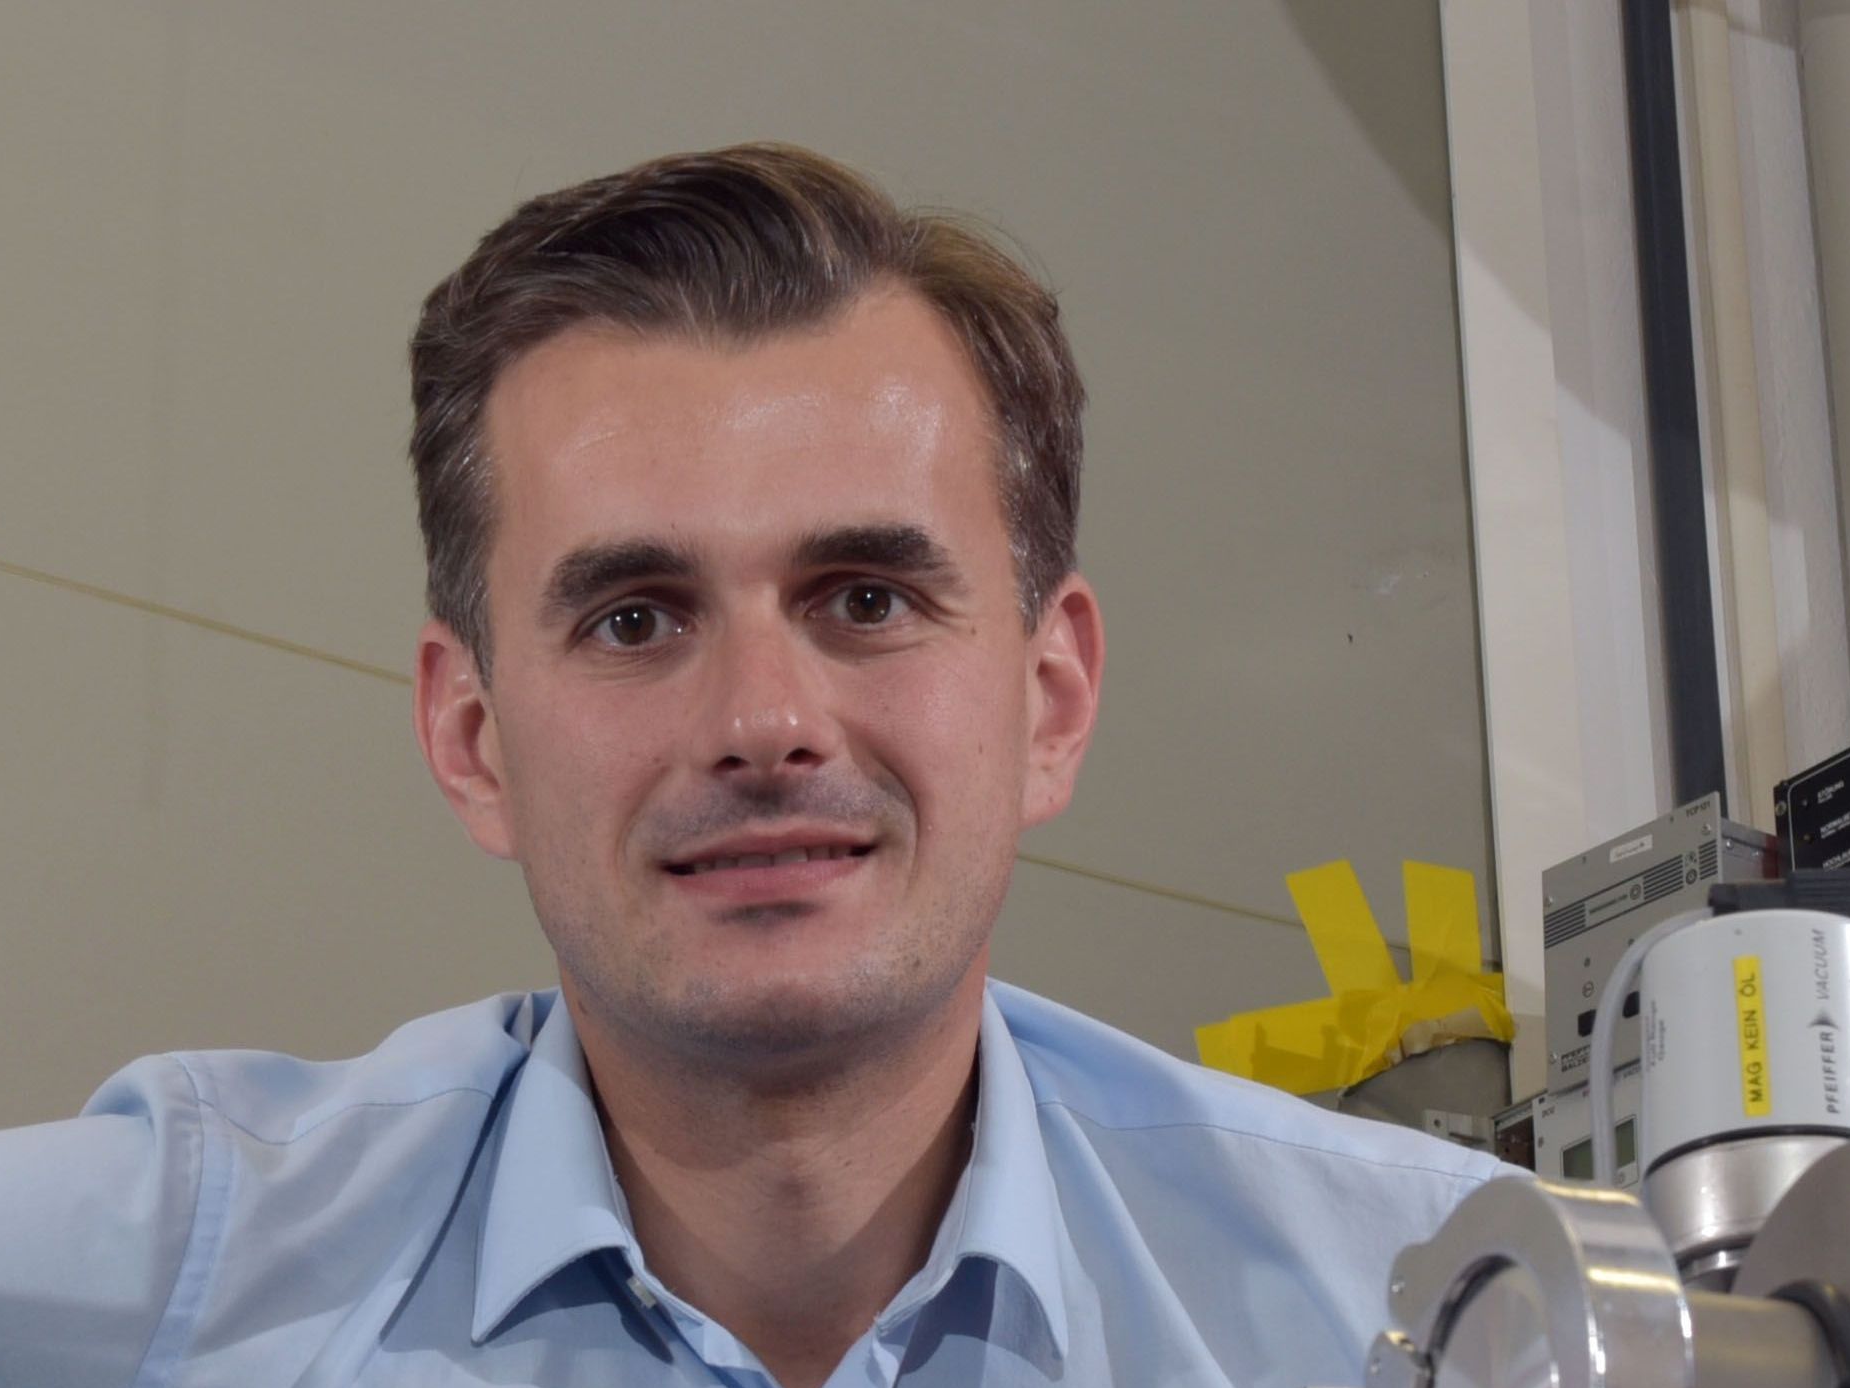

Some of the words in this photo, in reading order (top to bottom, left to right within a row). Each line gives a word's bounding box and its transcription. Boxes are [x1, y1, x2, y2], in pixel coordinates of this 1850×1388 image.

[1738, 972, 1758, 998] ÖL
[1812, 928, 1831, 1001] VACUUM
[1742, 1009, 1760, 1052] KEIN
[1745, 1060, 1765, 1103] MAG
[1819, 1031, 1840, 1115] PFEIFFER
